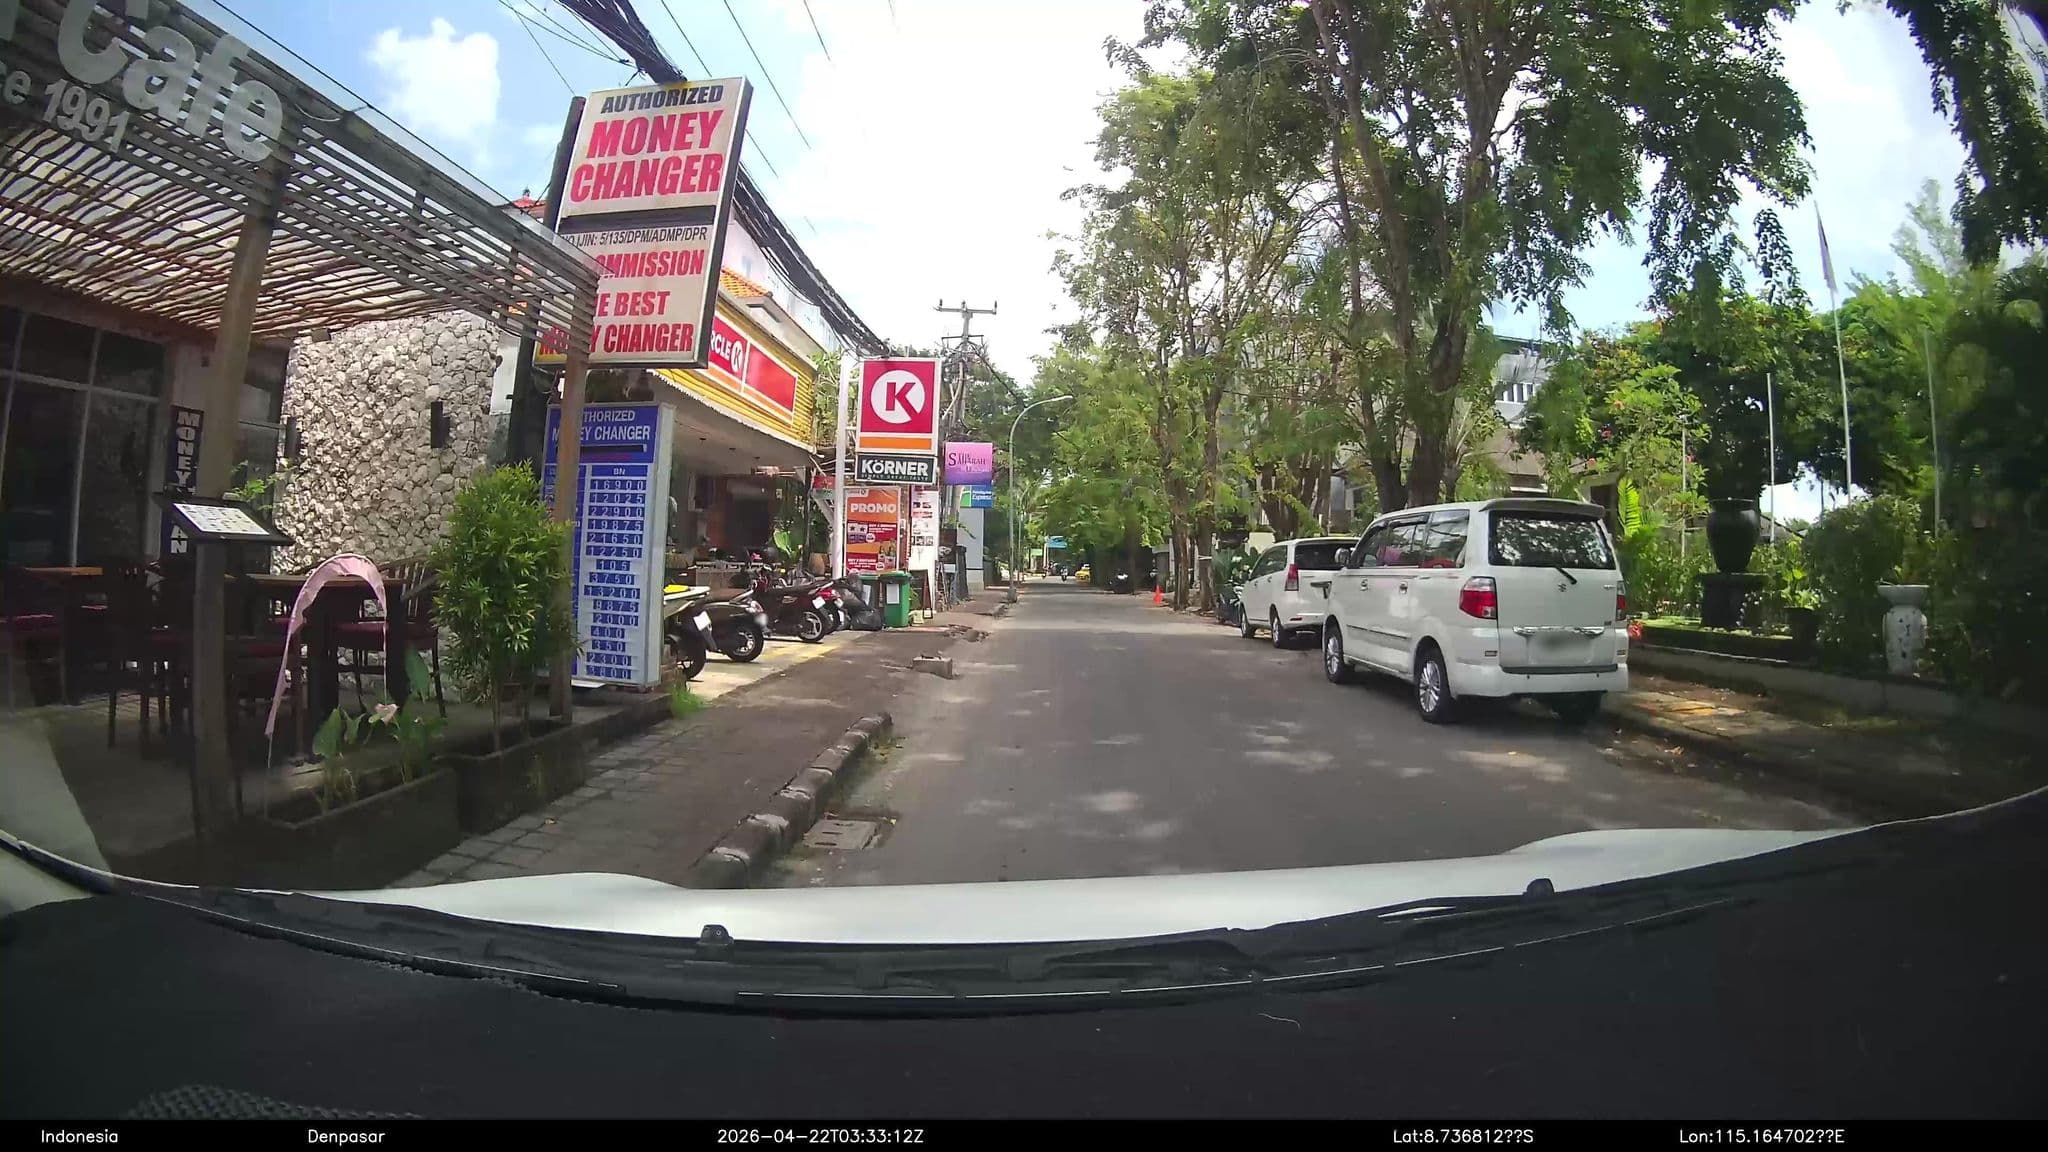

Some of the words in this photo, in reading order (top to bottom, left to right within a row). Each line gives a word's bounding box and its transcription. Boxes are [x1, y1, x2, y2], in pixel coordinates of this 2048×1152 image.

[58, 0, 284, 162] Cafe
[600, 85, 724, 114] AUTHORIZED
[43, 79, 130, 153] 1991
[586, 109, 724, 159] MONEY
[570, 153, 724, 203] CHANGER
[595, 249, 704, 278] OMMISSION
[613, 291, 670, 317] BEST
[603, 323, 695, 353] CHANGER
[710, 330, 732, 361] RCLE
[882, 379, 921, 422] K
[583, 410, 636, 422] THORIZED
[594, 425, 650, 441] CHANGER
[175, 411, 200, 487] MONEY
[861, 459, 929, 476] KÖRNER
[593, 480, 644, 491] 16900
[592, 493, 643, 504] 12025
[591, 506, 642, 517] 22900
[850, 503, 897, 514] PROMO
[591, 520, 642, 531] 19875
[589, 532, 641, 545] 21650
[590, 546, 639, 558] 12250
[600, 561, 627, 570] 105
[591, 573, 632, 584] 3750
[587, 586, 638, 599] 13200
[596, 614, 636, 625] 2000
[593, 627, 623, 637] 400
[594, 641, 623, 651] 350
[589, 653, 628, 665] 2300
